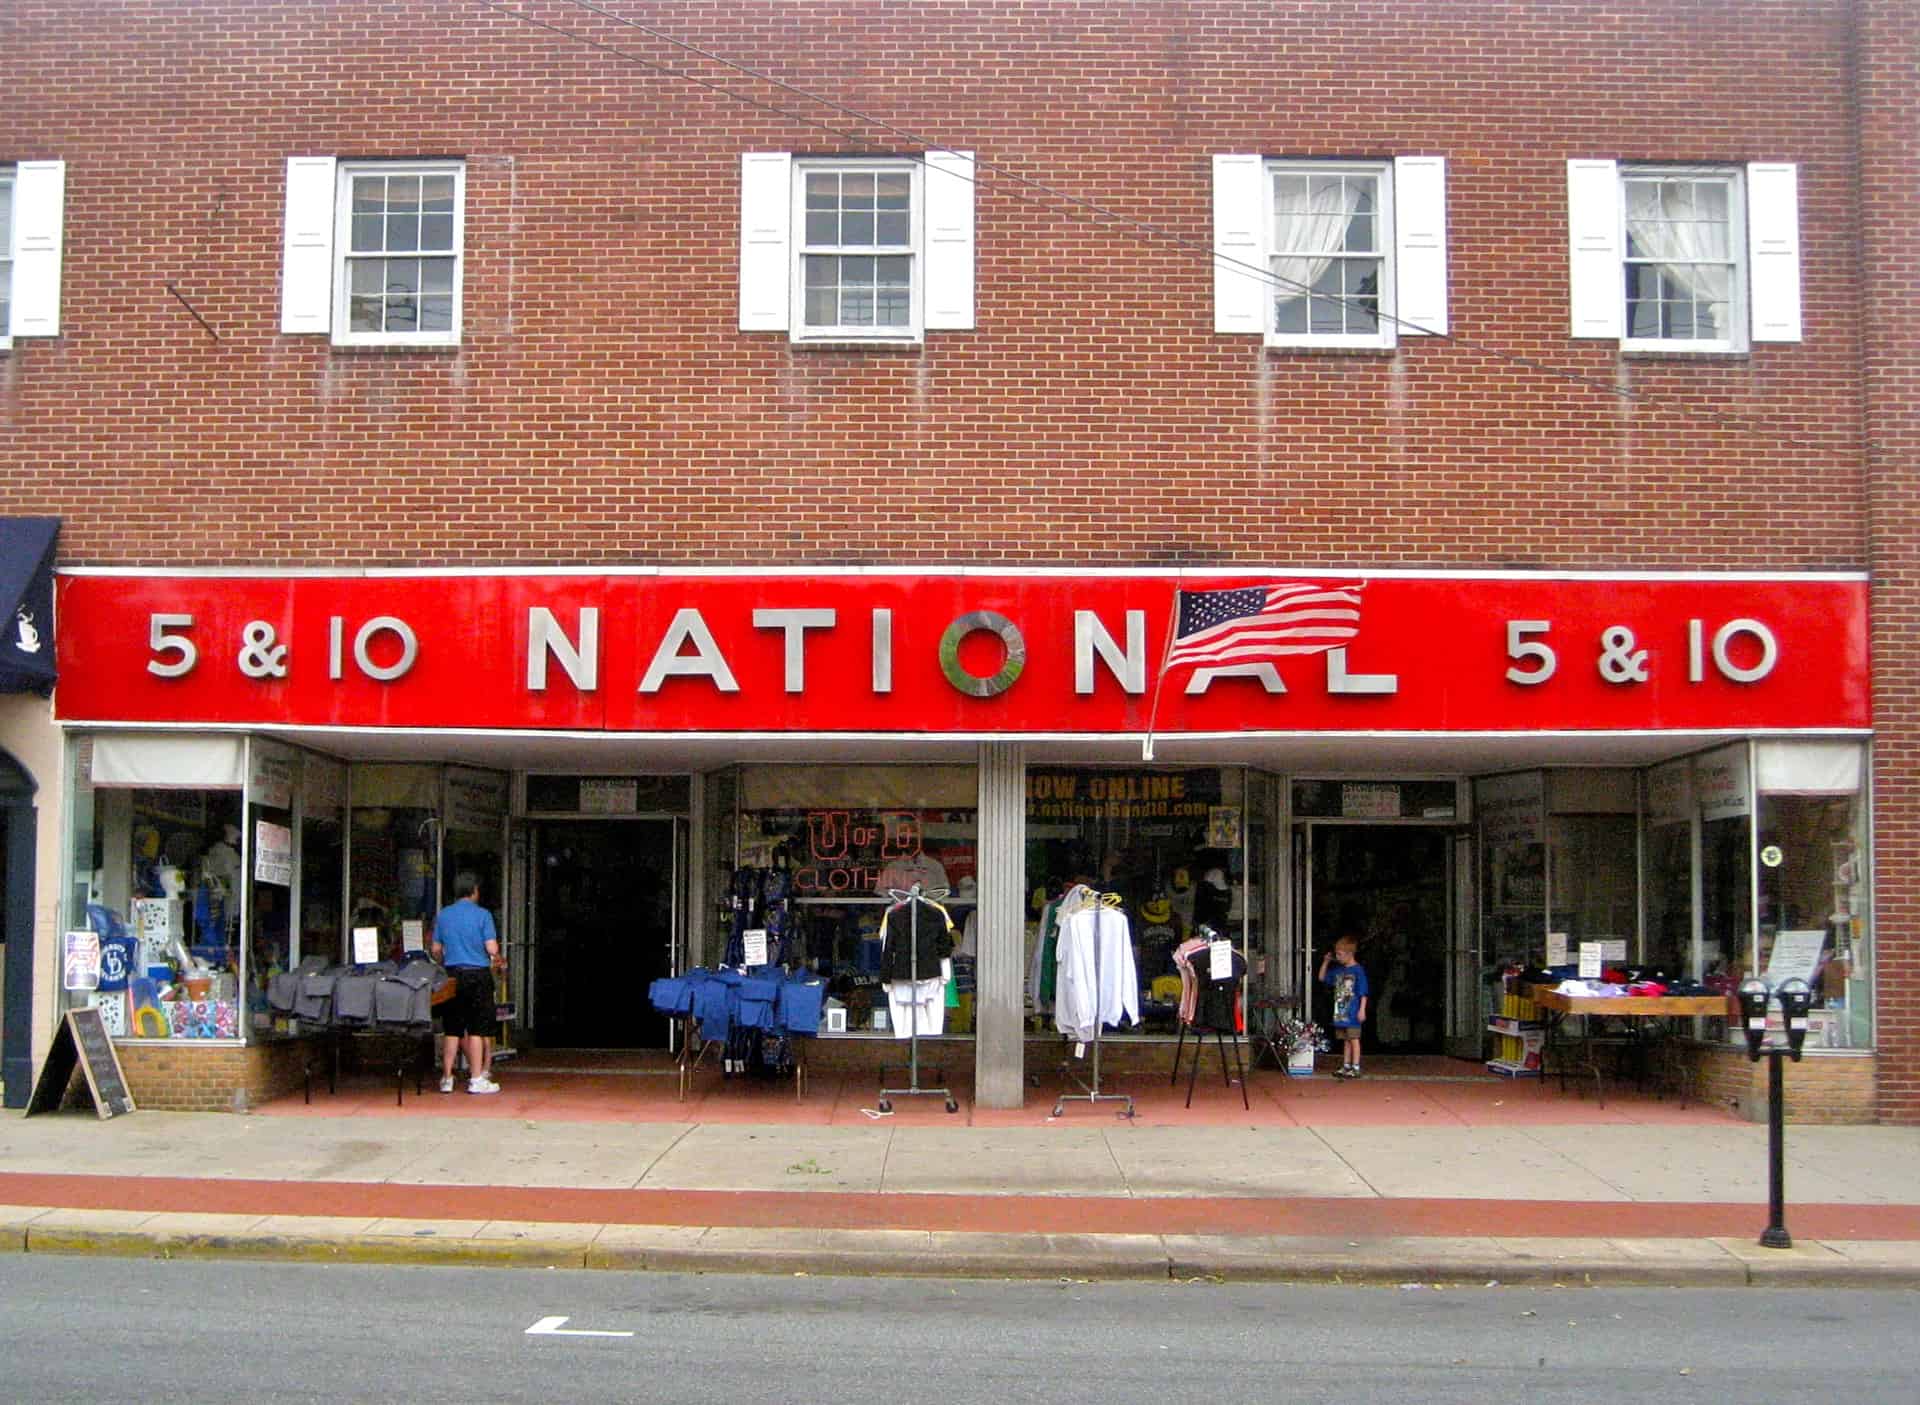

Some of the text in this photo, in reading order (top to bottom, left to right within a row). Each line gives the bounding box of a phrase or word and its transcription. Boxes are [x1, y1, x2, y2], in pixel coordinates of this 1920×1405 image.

[147, 613, 417, 681] 5 & 10
[1507, 618, 1778, 685] 5 & 10
[1089, 776, 1185, 800] ONLINE
[808, 811, 922, 861] U OF D
